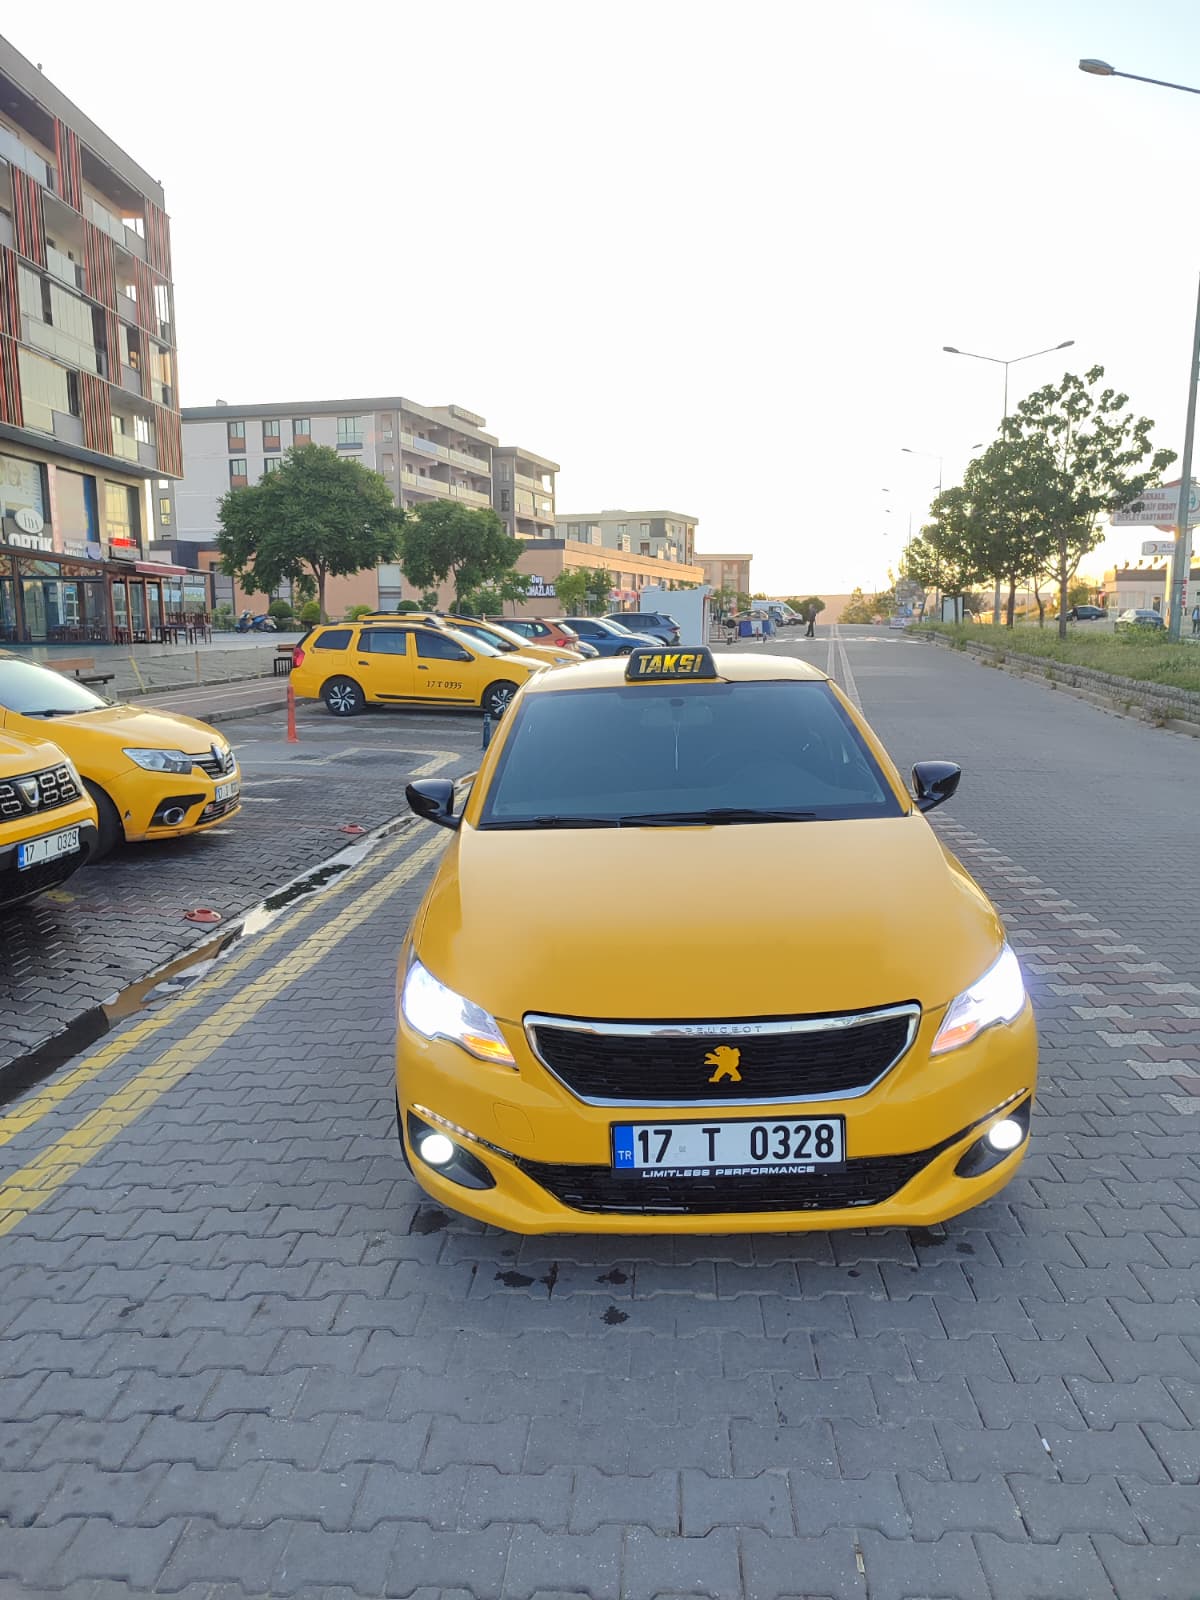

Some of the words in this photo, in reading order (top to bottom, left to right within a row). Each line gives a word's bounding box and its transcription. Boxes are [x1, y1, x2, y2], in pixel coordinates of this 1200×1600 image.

[25, 844, 35, 862] 17
[44, 839, 48, 856] T
[57, 831, 77, 851] 0329
[685, 1025, 762, 1034] PEUGEOT
[638, 1129, 672, 1163] 17
[702, 1127, 721, 1162] T
[750, 1124, 834, 1160] 0328
[617, 1150, 632, 1160] TR
[642, 1169, 710, 1178] LIMITLESS
[715, 1166, 815, 1176] PERFORMANCE
